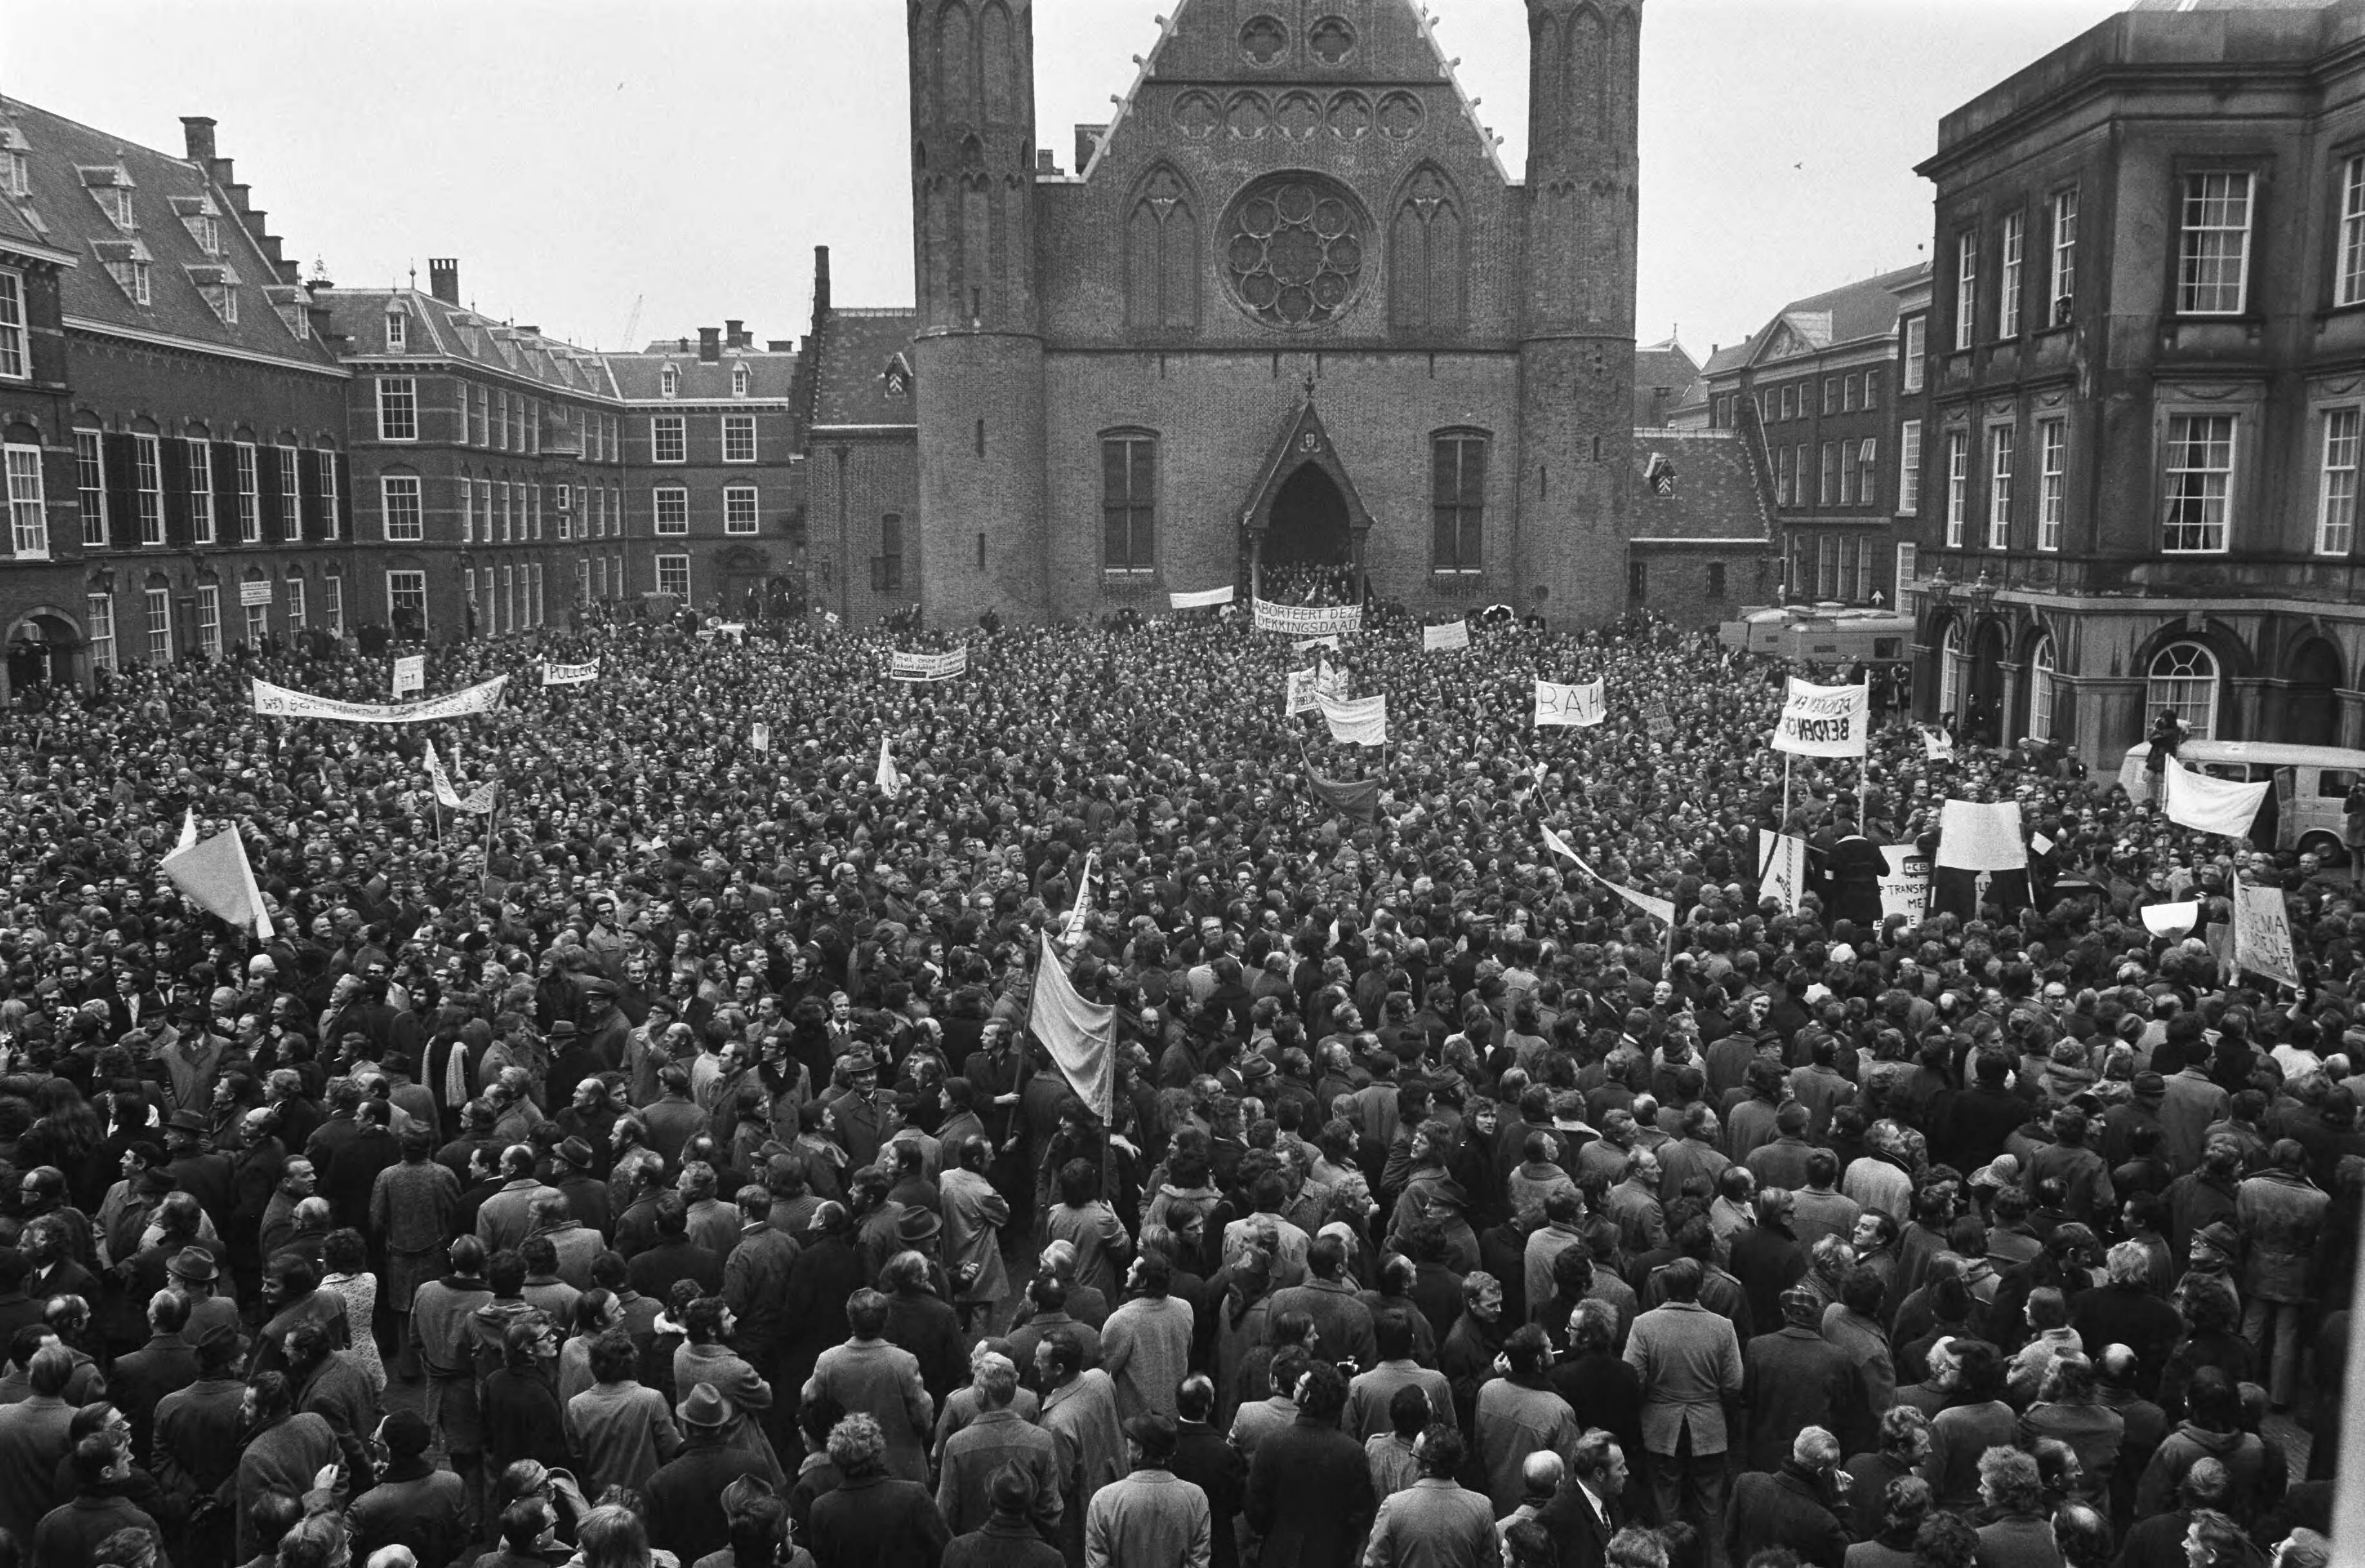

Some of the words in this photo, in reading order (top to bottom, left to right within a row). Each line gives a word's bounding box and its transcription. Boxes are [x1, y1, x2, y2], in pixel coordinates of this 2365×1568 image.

[1255, 600, 1324, 620] ABORTEERT
[1330, 606, 1362, 619] DEZE
[1258, 614, 1357, 633] DEKKINGSDAAD
